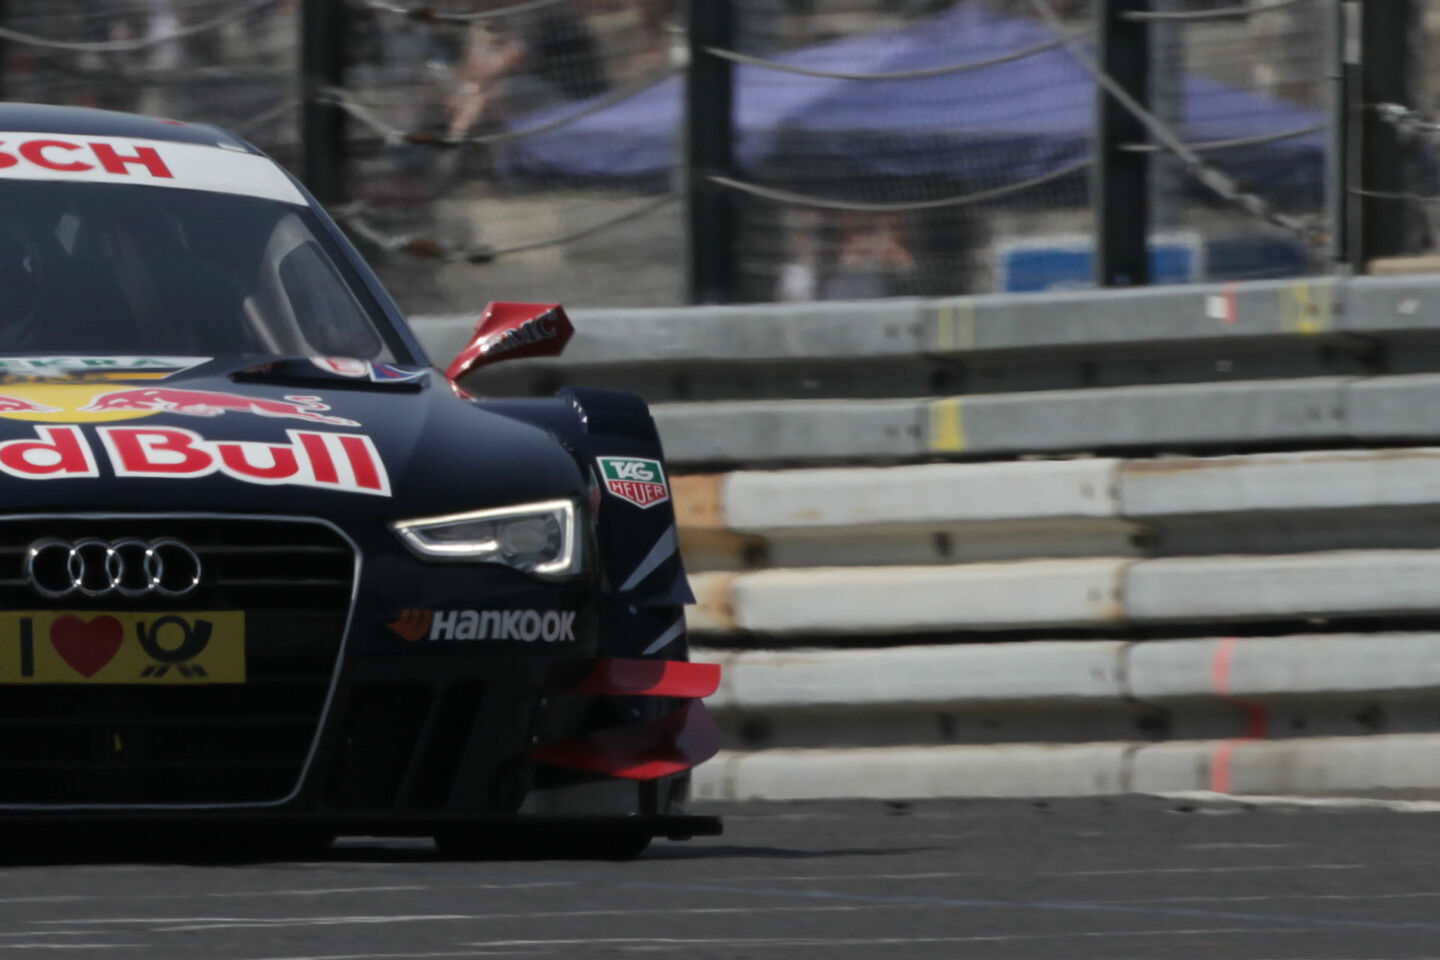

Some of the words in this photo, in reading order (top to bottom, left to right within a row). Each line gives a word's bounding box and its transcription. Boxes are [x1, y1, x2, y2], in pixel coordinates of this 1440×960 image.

[98, 426, 390, 497] Bull
[608, 461, 655, 481] TAG
[610, 481, 664, 504] HEUER
[20, 617, 34, 678] I
